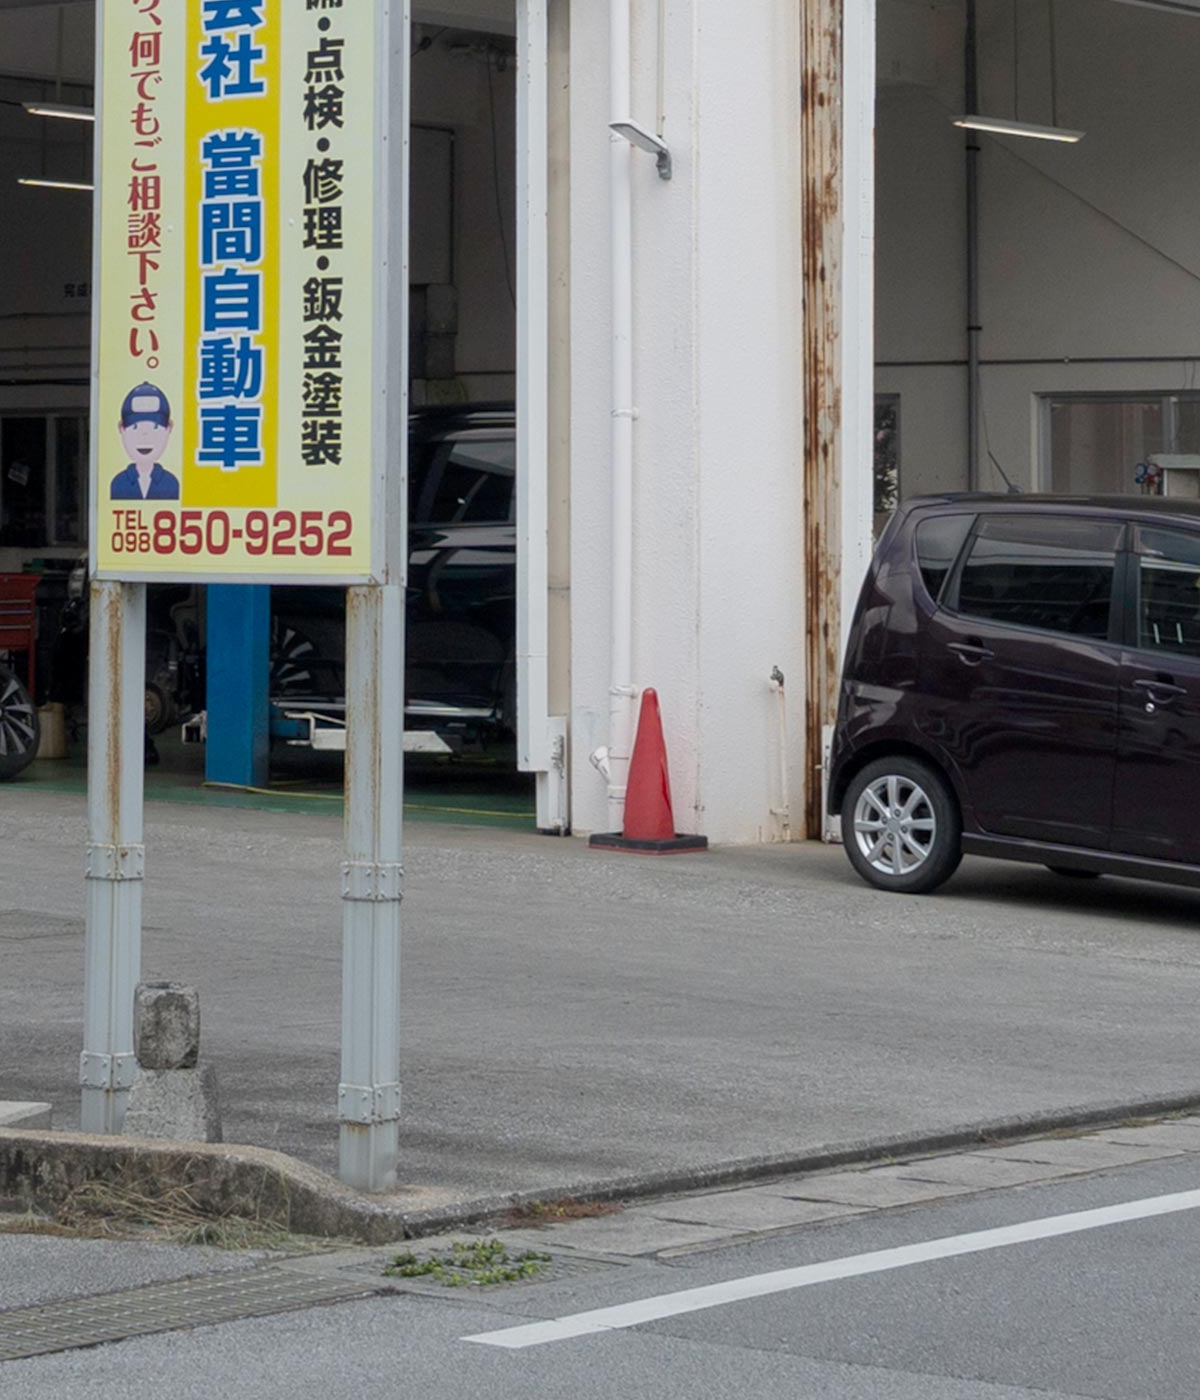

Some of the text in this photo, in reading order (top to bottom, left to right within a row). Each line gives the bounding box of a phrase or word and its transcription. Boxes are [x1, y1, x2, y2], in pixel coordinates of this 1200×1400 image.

[198, 131, 263, 468] 當間自動車
[111, 510, 352, 557] 098 850-9252
[112, 509, 148, 531] TEL
